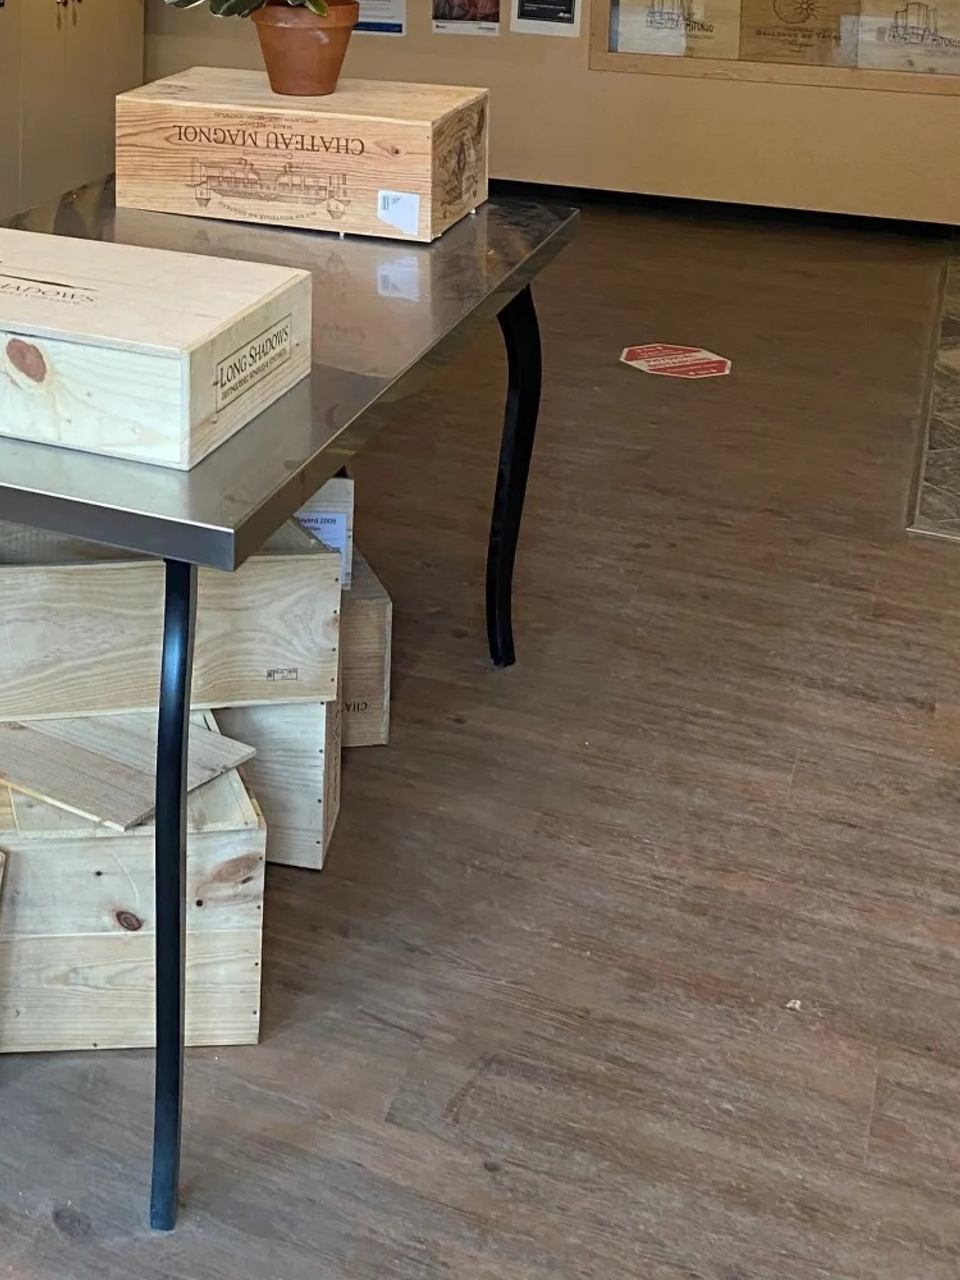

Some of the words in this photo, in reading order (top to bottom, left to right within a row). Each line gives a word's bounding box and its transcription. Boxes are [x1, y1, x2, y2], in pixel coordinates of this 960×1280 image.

[172, 125, 259, 148] MAGNOL
[220, 354, 247, 388] LONG
[248, 325, 289, 368] SHADOWS
